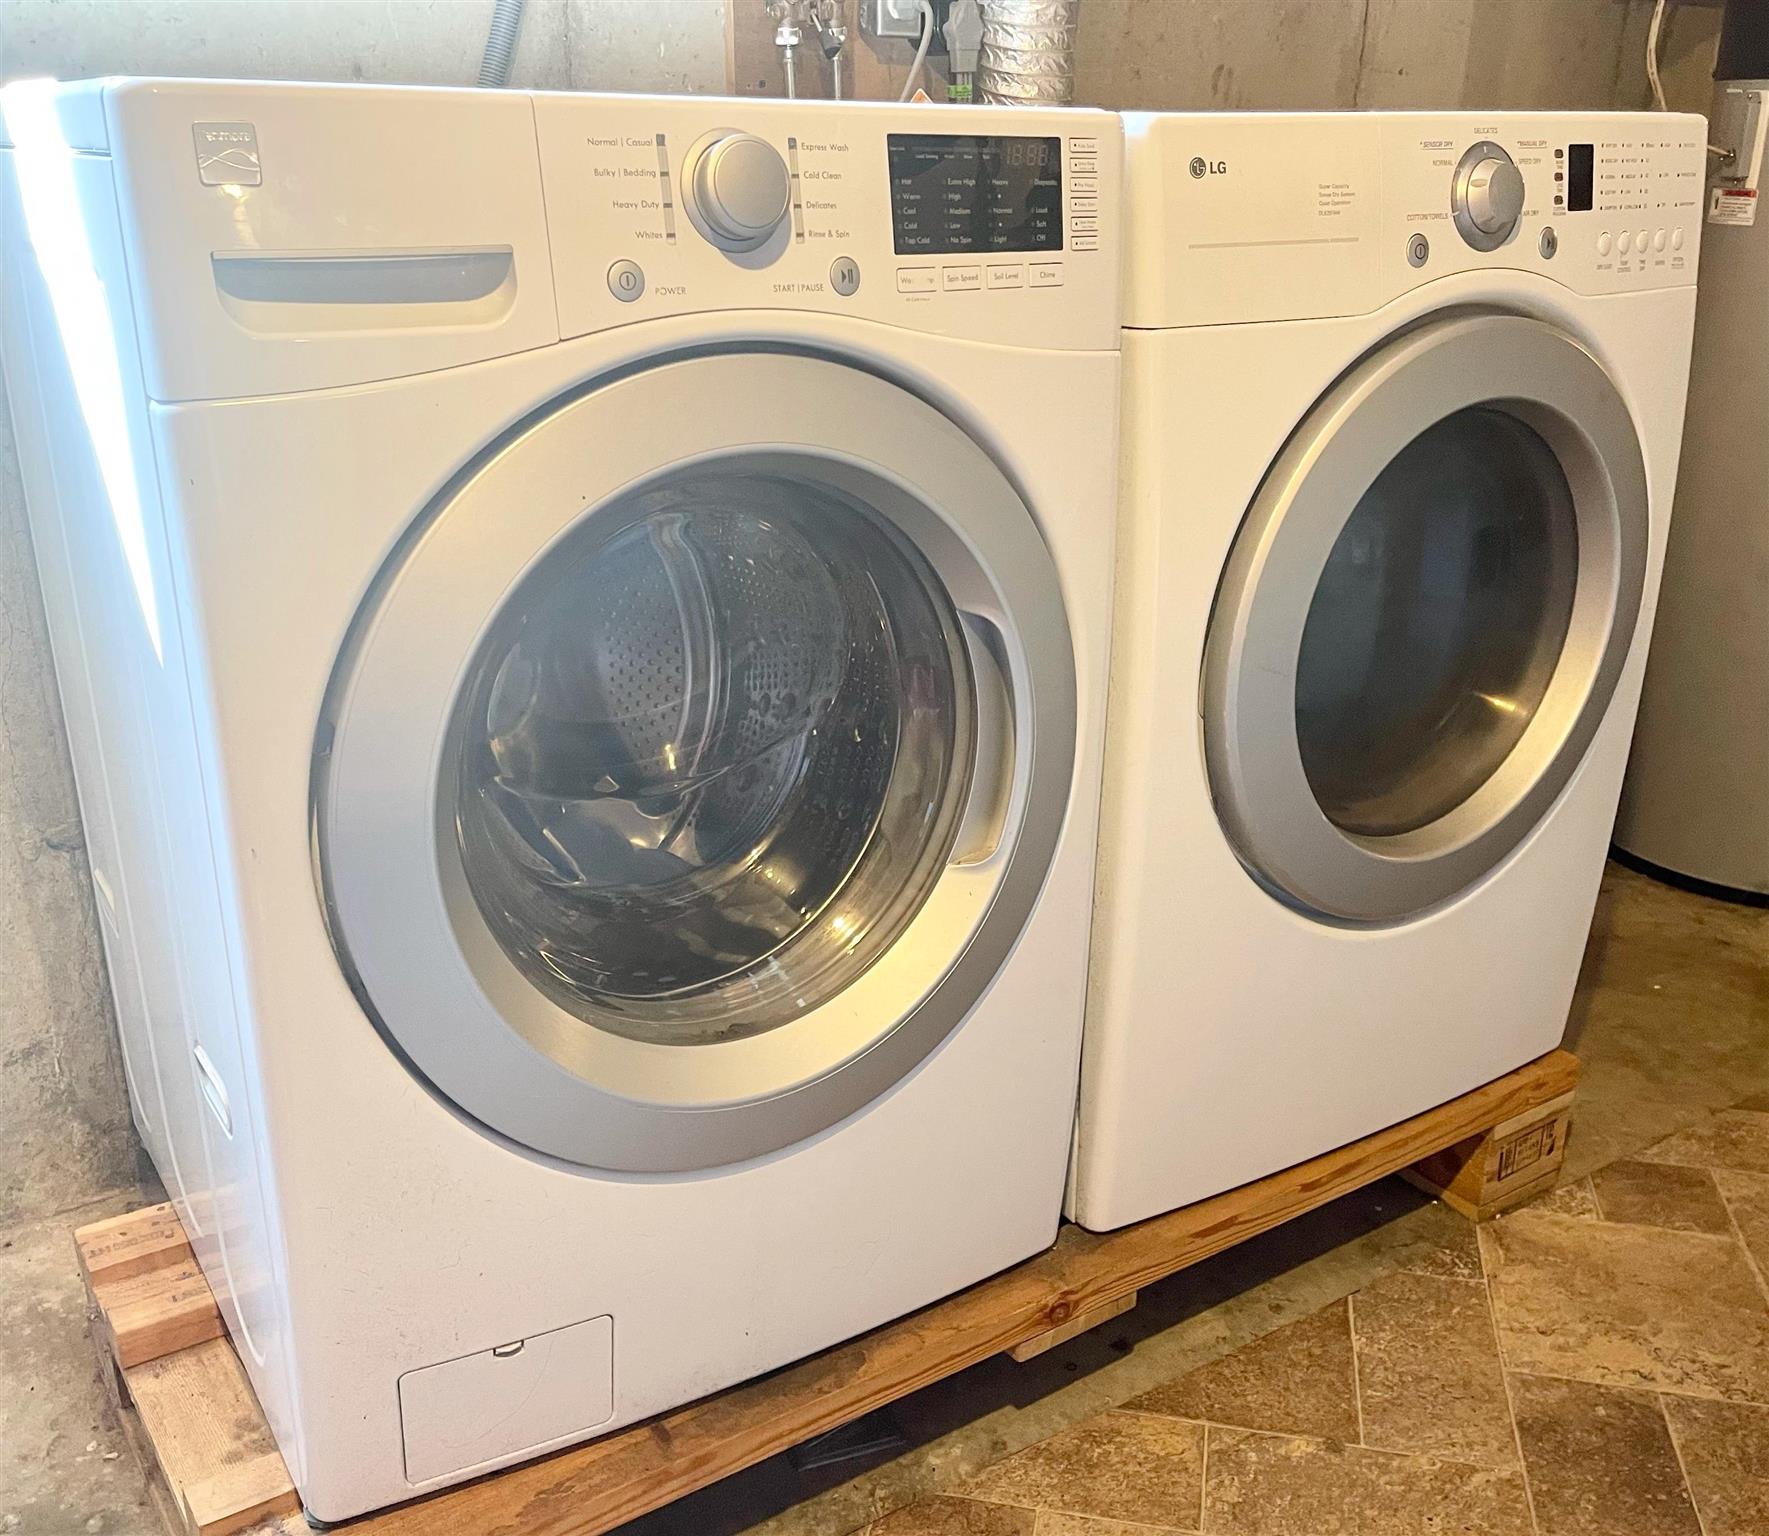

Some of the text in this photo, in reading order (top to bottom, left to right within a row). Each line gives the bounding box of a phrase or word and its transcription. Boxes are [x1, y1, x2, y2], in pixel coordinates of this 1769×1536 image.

[587, 137, 653, 147] Normal Casual
[801, 142, 849, 152] Express Wash
[1209, 162, 1227, 174] LG
[594, 168, 657, 178] Bulky Bedding
[803, 171, 842, 180] Cold Clean
[948, 192, 962, 201] High
[612, 200, 660, 210] Heavy Duty
[806, 200, 837, 209] Delicates
[904, 221, 918, 230] Cold
[635, 230, 663, 239] Whites
[808, 230, 850, 239] Rinse & Spin
[917, 236, 930, 244] Cold
[947, 274, 960, 283] Spin
[961, 273, 979, 283] Speed
[994, 271, 1019, 280] Soil Level
[655, 287, 687, 296] POWER
[773, 283, 824, 293] START PAUSE
